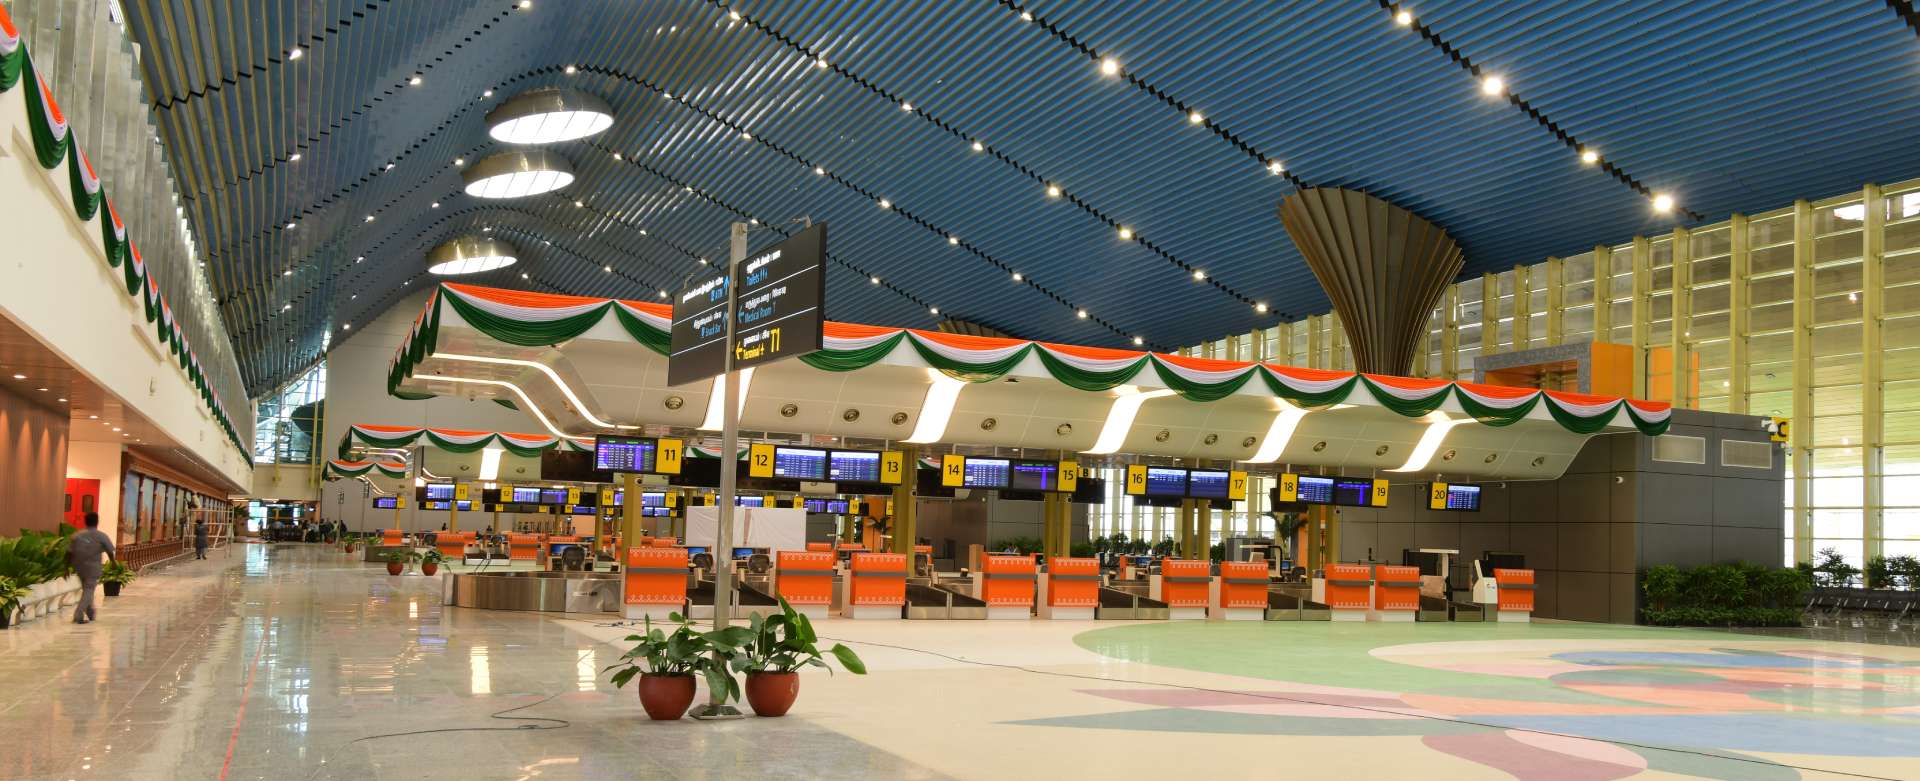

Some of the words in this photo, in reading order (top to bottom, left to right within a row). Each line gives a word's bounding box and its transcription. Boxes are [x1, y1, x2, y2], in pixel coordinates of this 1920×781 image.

[771, 328, 780, 352] T1
[743, 344, 760, 360] Terminal
[664, 449, 676, 461] 11
[755, 454, 768, 466] 12
[887, 461, 899, 473] 13
[948, 464, 960, 475] 14
[1082, 468, 1089, 477] B
[1063, 469, 1074, 480] 15
[1132, 473, 1143, 484] 16
[1234, 479, 1244, 489] 17
[1284, 482, 1294, 492] 18
[1377, 487, 1386, 496] 19
[1434, 490, 1446, 500] 20
